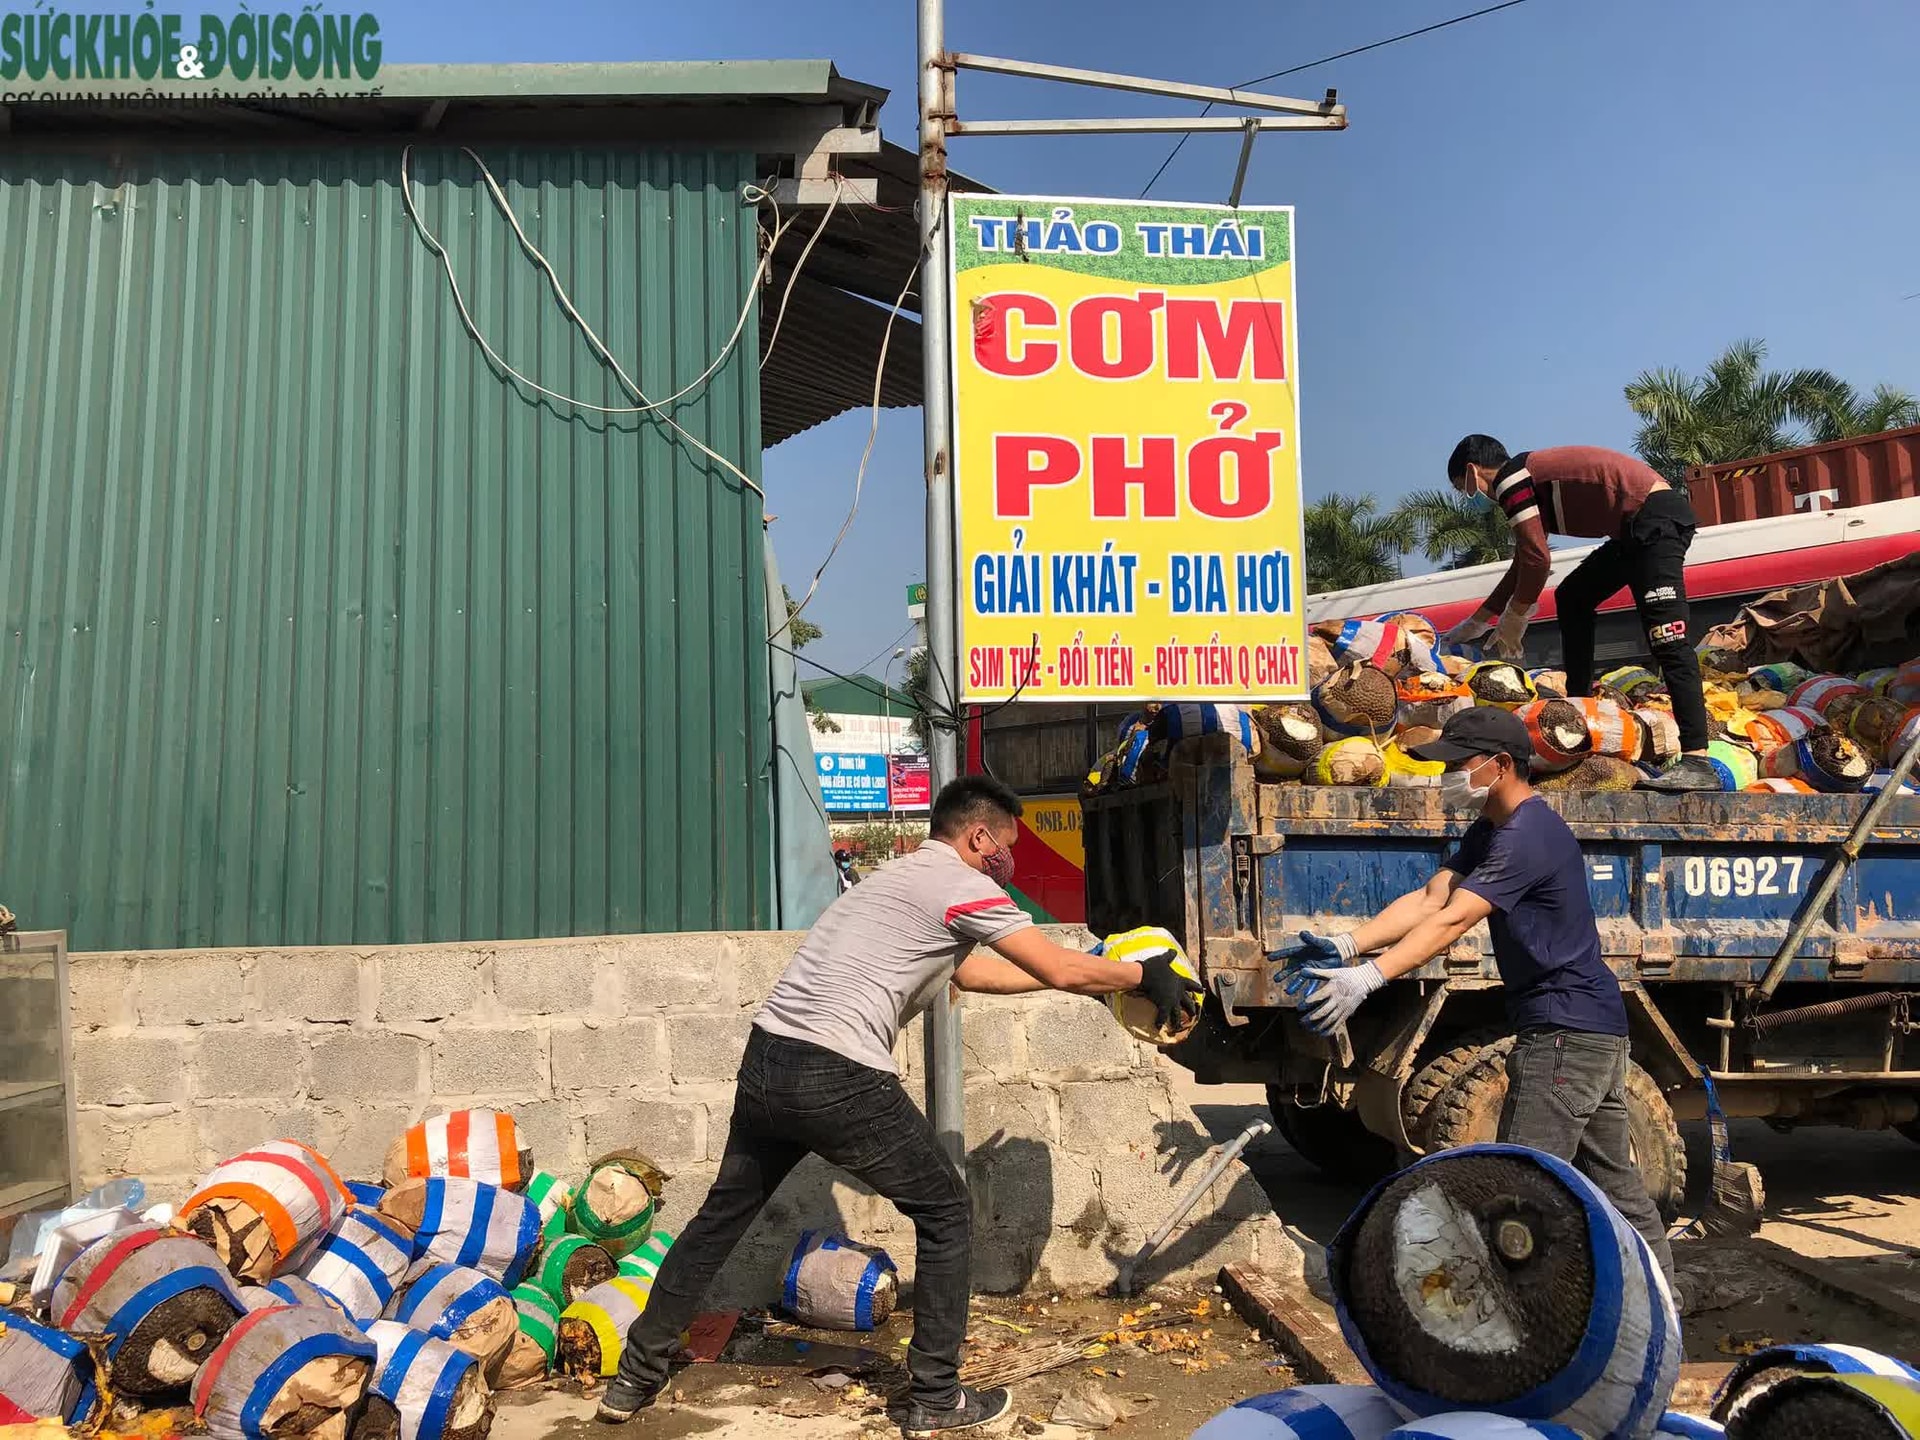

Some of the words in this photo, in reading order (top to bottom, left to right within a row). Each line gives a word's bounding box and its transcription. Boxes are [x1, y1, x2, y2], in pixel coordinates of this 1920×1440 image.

[973, 209, 1119, 252] THẢO
[1139, 221, 1262, 257] THÁI
[974, 291, 1286, 380] CƠM
[995, 402, 1282, 519] PHỞ
[974, 529, 1040, 614] GIẢI
[1052, 542, 1137, 613] KHÁT
[1171, 555, 1227, 613] BIA
[1237, 550, 1291, 613] HƠI
[970, 646, 1004, 688] SIM
[1009, 634, 1042, 687] THẺ
[1059, 631, 1089, 686] ĐỔI
[1094, 633, 1133, 686] TIỀN
[1156, 638, 1188, 685] RÚT
[1194, 633, 1232, 685] TIỀN
[1255, 638, 1299, 685] CHÁT
[1684, 857, 1803, 896] 06927
